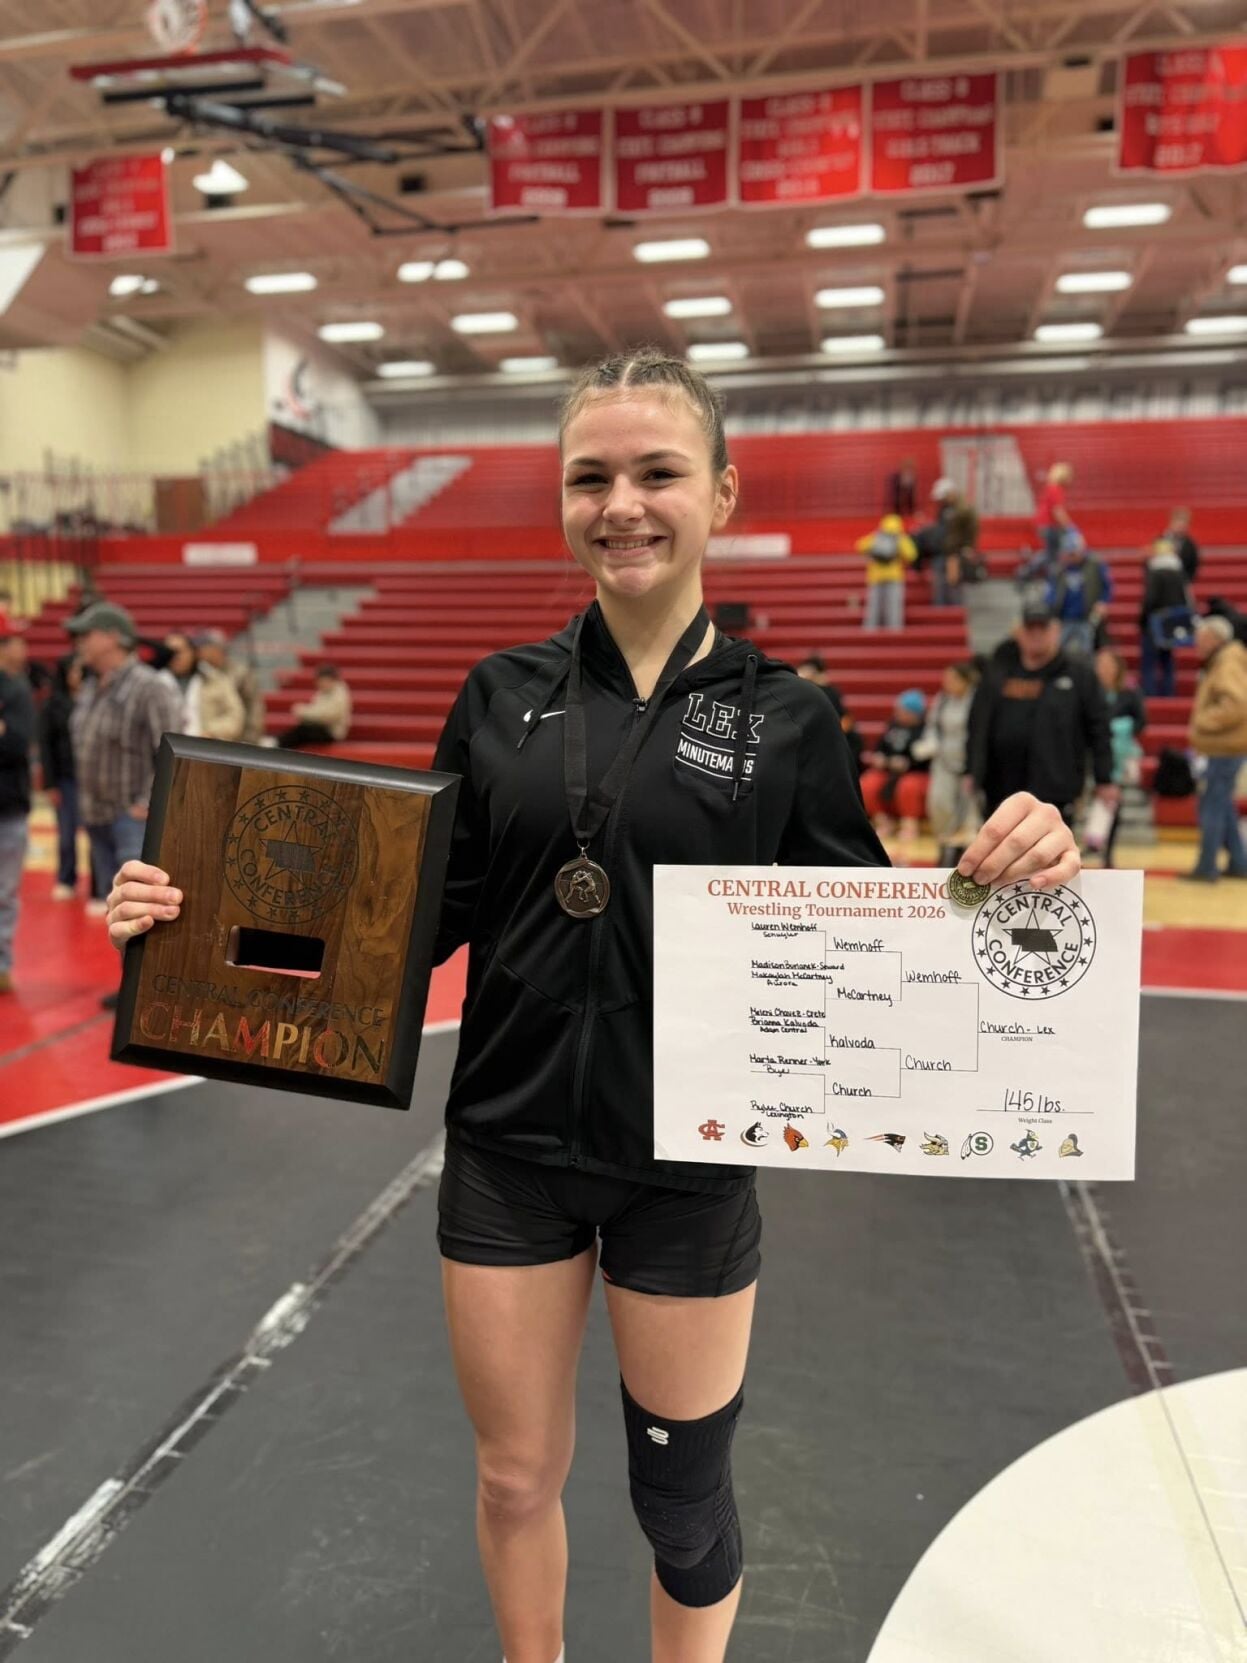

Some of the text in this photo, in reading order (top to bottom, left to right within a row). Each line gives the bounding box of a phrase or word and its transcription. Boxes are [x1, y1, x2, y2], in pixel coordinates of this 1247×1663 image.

[677, 738, 754, 775] MINUTEMAS
[707, 879, 811, 898] CENTRAL
[816, 881, 949, 900] CONFERENC
[727, 902, 946, 920] Wrestling Tournament 2026
[996, 895, 1073, 927] CENTRAL
[751, 922, 780, 931] Lauren
[833, 936, 885, 952] Wemhoff
[988, 939, 1079, 984] CONFERENCE
[905, 970, 962, 984] Wemhoff
[152, 974, 386, 1028] CENTRAL CONFERENCE
[837, 986, 893, 1008] McCartney
[139, 1001, 386, 1075] CHAMPION
[829, 1033, 876, 1049] Kalvoda
[904, 1054, 952, 1071] Church
[832, 1082, 872, 1097] Church
